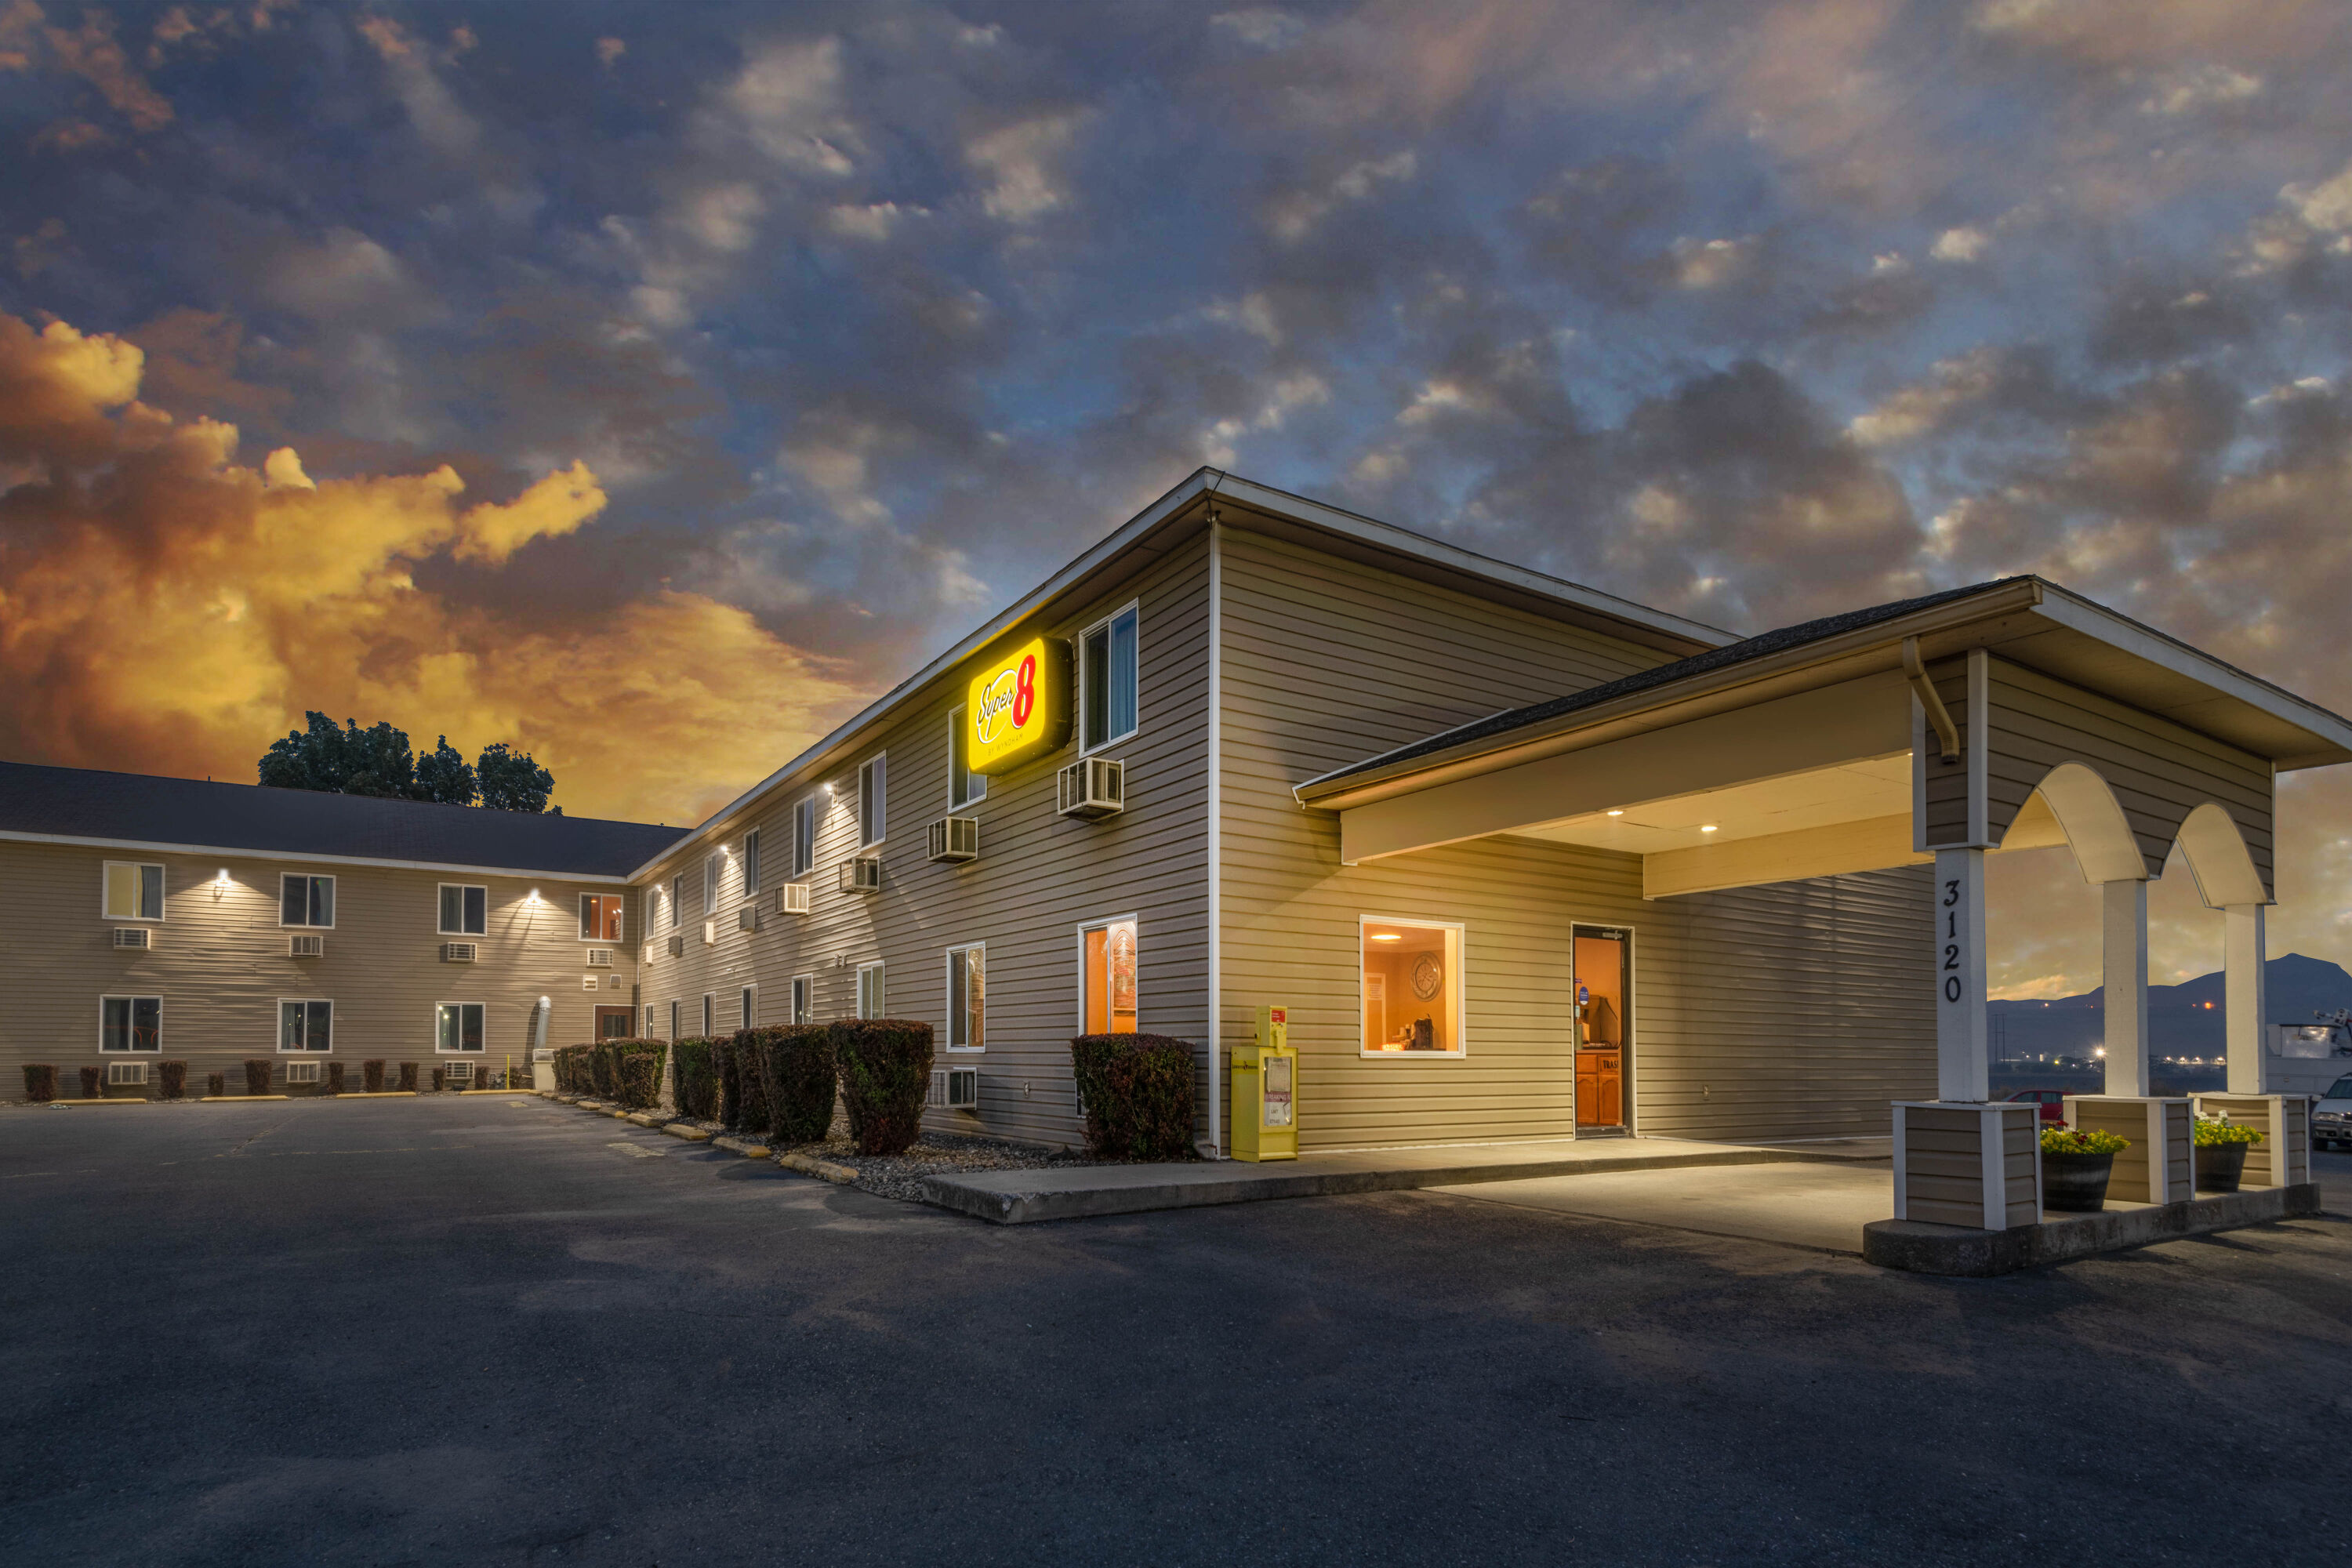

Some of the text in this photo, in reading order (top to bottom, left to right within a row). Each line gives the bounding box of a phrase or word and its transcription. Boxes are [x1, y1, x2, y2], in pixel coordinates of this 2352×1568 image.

[977, 654, 1036, 740] Super 8
[996, 732, 1022, 752] WYNDHAM
[1944, 880, 1962, 1004] 3120
